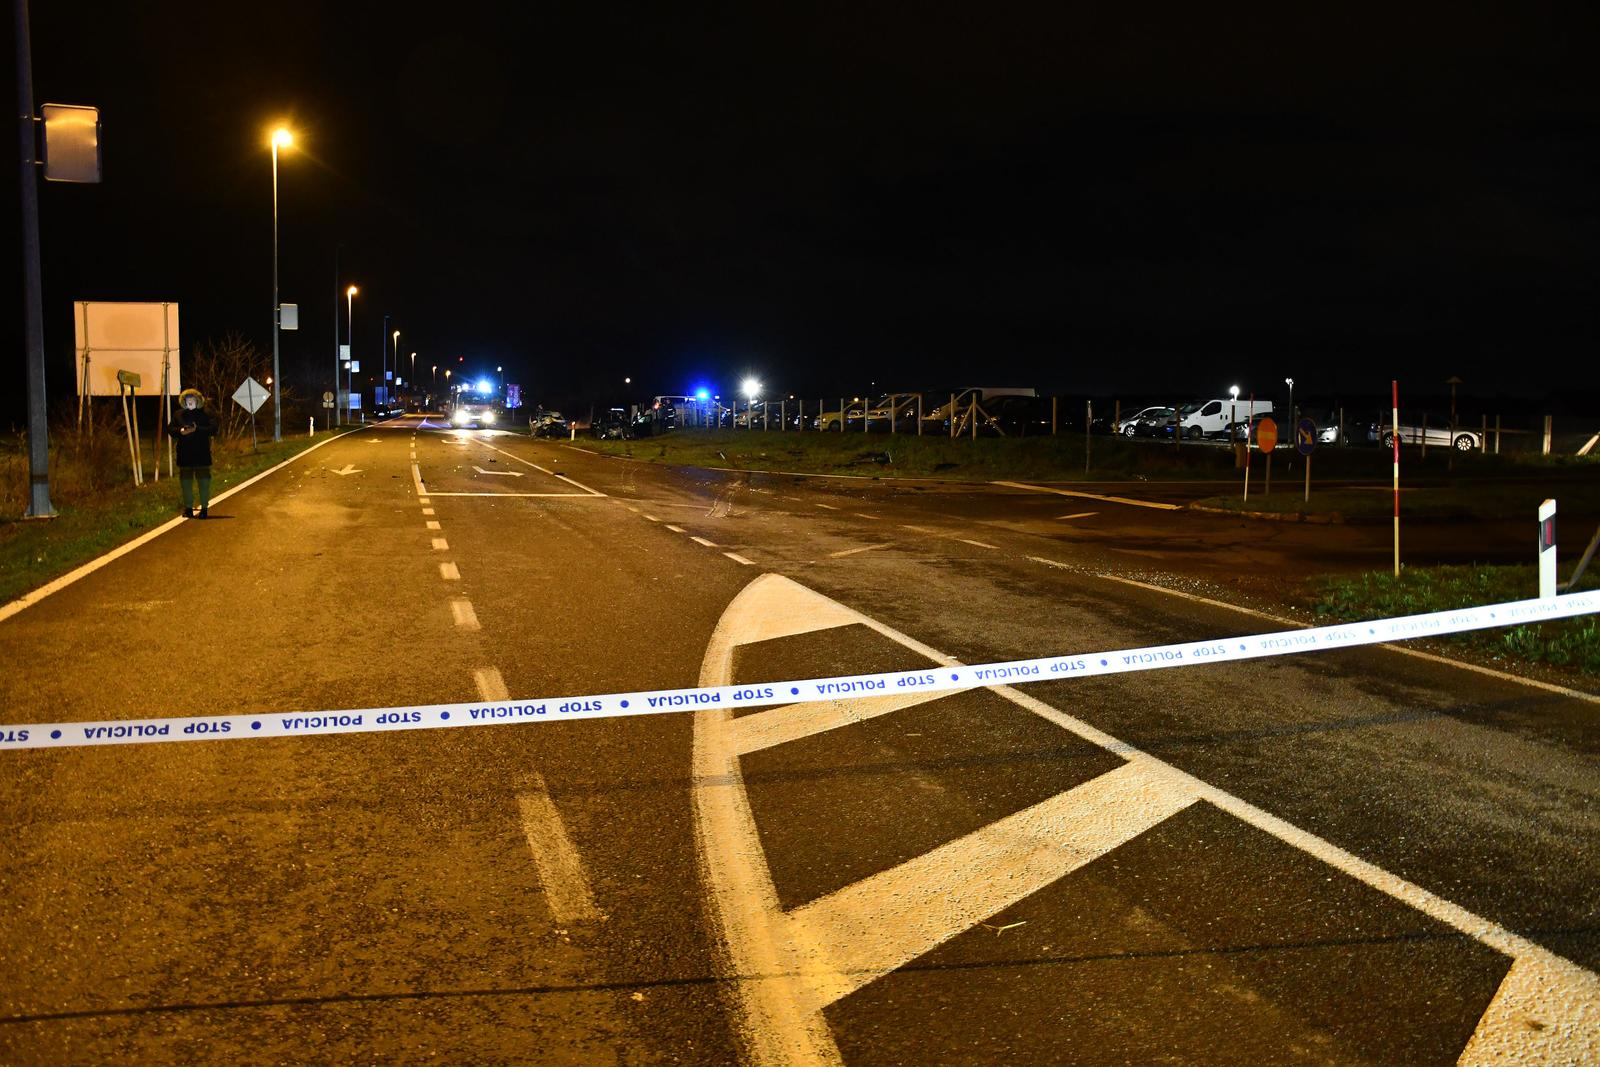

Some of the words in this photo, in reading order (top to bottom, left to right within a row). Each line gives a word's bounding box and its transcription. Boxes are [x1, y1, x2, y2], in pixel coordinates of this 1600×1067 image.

[1325, 629, 1357, 641] STOP
[1260, 635, 1317, 650] POLICIJA
[1123, 650, 1183, 664] POLICIJA
[1193, 645, 1227, 658] STOP
[975, 664, 1039, 680] POLICIJA
[1050, 659, 1086, 672] STOP
[816, 679, 885, 695] POLICIJA
[897, 674, 935, 687] STOP
[647, 691, 721, 708] POLICIJA
[733, 688, 774, 700] STOP
[469, 703, 546, 719] POLICIJA
[559, 700, 602, 713] STOP
[282, 714, 362, 730] POLICIJA
[376, 711, 421, 724] STOP
[84, 723, 169, 740] POLICIJA
[184, 720, 231, 734] STOP
